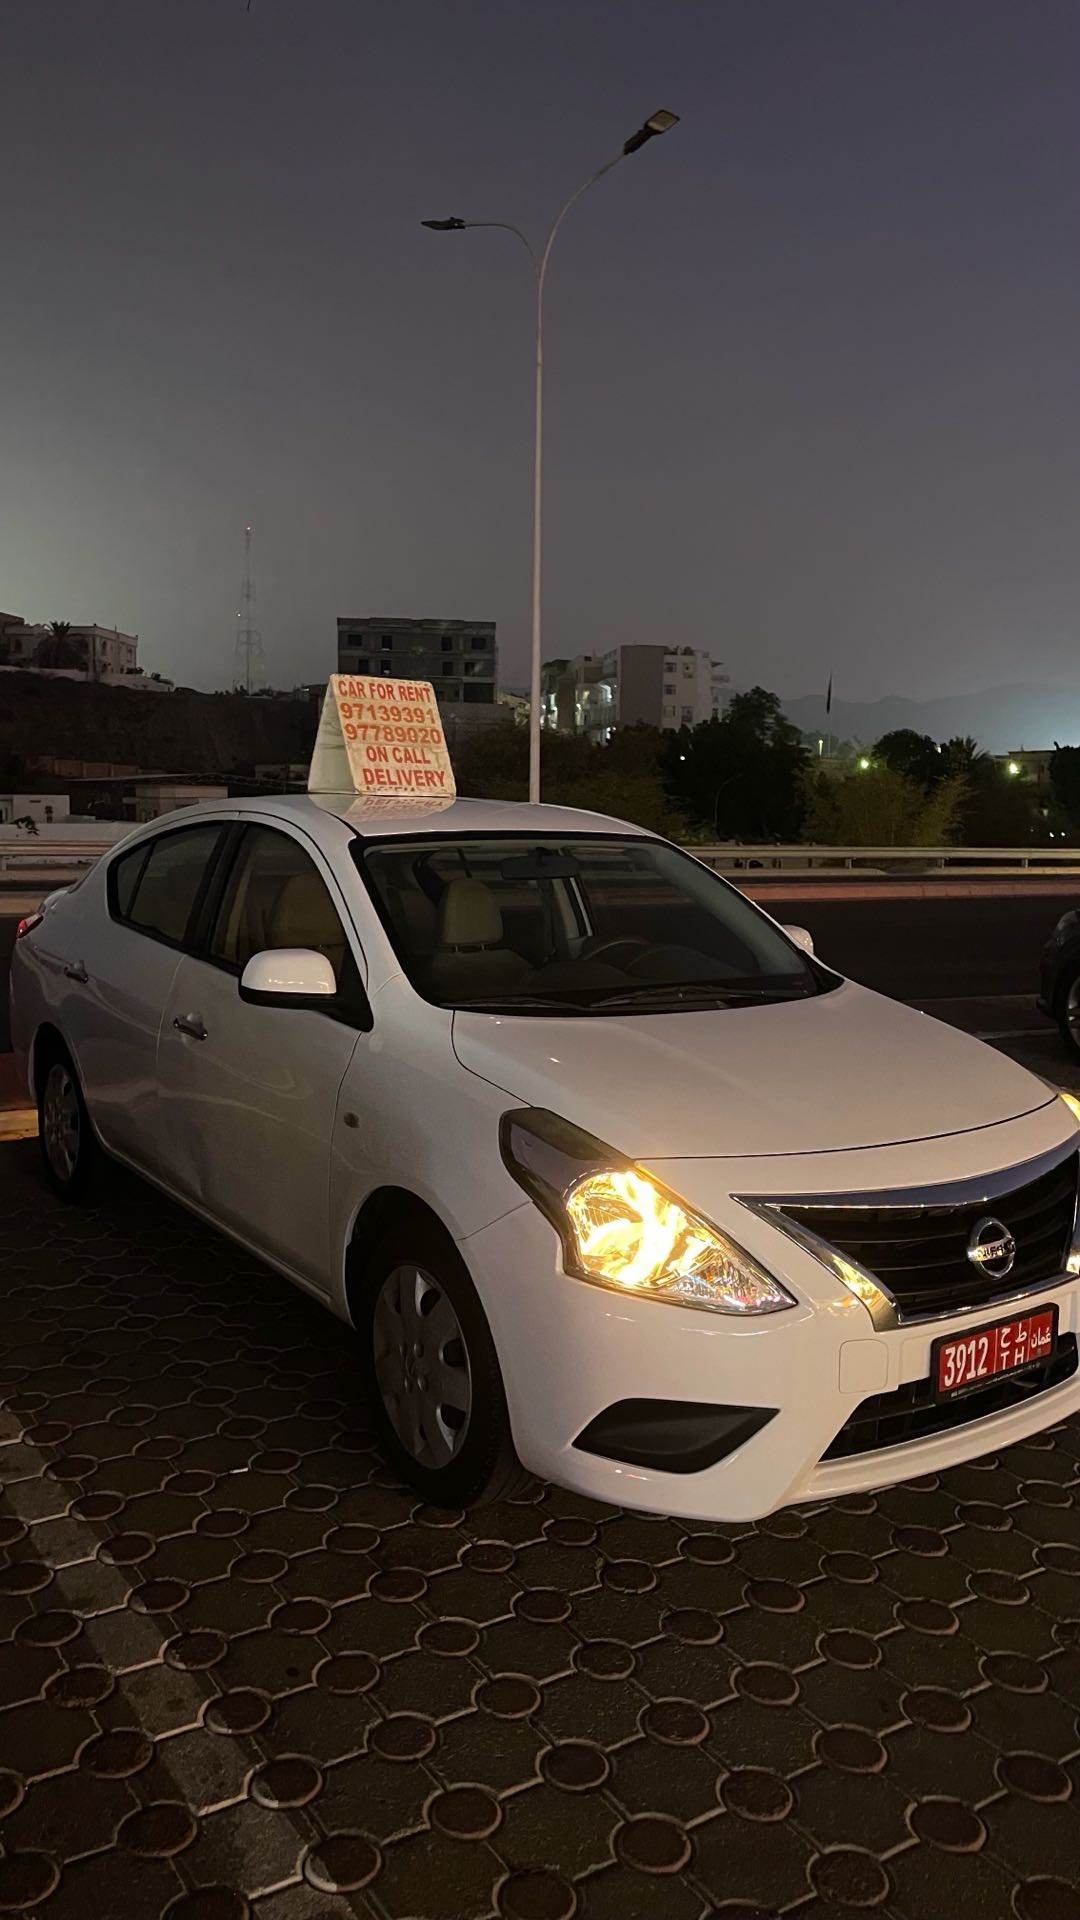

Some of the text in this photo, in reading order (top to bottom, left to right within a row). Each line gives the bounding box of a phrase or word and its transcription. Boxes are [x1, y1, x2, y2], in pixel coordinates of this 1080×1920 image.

[339, 681, 431, 703] CAR FOR RENT
[340, 702, 436, 724] 97139391
[344, 723, 442, 744] 97789020
[366, 746, 431, 764] ON CALL
[362, 768, 445, 787] DELIVERY
[944, 1336, 989, 1387] 3912
